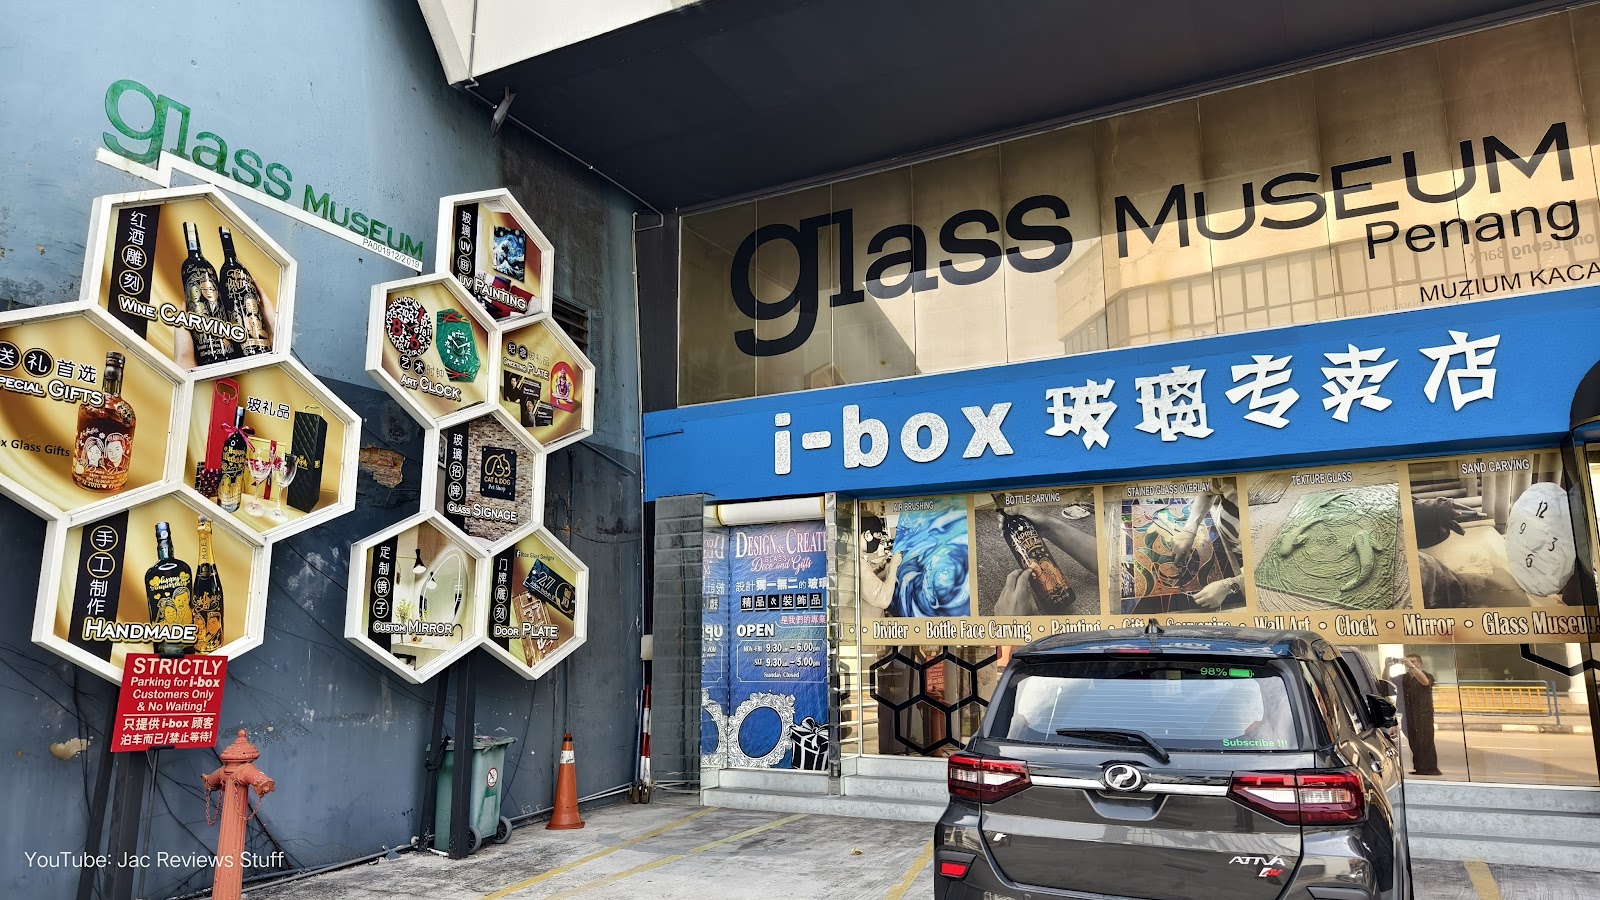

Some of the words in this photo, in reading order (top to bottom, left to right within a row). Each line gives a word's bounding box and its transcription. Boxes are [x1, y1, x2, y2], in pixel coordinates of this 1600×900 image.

[102, 79, 292, 202] glass
[303, 184, 424, 261] MUSEUM
[1365, 199, 1580, 260] Penang
[730, 194, 1073, 357] glass
[1114, 121, 1574, 258] MUSEUM
[362, 238, 420, 268] PA001912/2019
[1420, 273, 1521, 303] MUZIUM
[1530, 261, 1600, 287] KACA
[459, 276, 472, 287] UV
[475, 278, 526, 308] PAINTING
[119, 295, 156, 317] WINE
[160, 304, 245, 340] CARVING
[528, 363, 550, 379] PLATE
[0, 377, 44, 394] PECIAL
[49, 380, 104, 405] GIFTS
[401, 375, 418, 388] ART
[420, 376, 461, 399] CLOCK
[247, 397, 290, 420] 玻礼品
[774, 402, 1014, 475] i-box
[1045, 329, 1501, 450] 玻璃专卖店
[11, 440, 41, 453] Glass
[44, 445, 70, 457] Gifts
[1461, 461, 1487, 474] SAND
[1489, 458, 1530, 473] CARVING
[499, 477, 511, 485] DOG
[1291, 473, 1326, 486] TEXTURE
[1327, 471, 1353, 483] GLASS
[1127, 485, 1154, 497] STAINED
[1156, 484, 1178, 495] GLASS
[1180, 482, 1211, 493] OVERLAY
[893, 502, 903, 512] AIR
[904, 501, 934, 511] BRUSHING
[1005, 495, 1030, 505] BOTTLE
[1031, 492, 1060, 503] CARVING
[448, 502, 470, 515] GLASS
[473, 504, 517, 521] SIGNAGE
[1535, 501, 1548, 519] 12
[1518, 522, 1527, 534] 9
[736, 531, 777, 558] DESIGN
[1547, 537, 1558, 551] 3
[86, 531, 113, 616] 手工制作
[85, 619, 198, 641] HANDMADE
[373, 621, 406, 633] CUSTOM
[408, 620, 453, 634] MIRROR
[495, 625, 519, 636] DOOR
[522, 622, 558, 637] PLATE
[736, 623, 775, 637] OPEN
[872, 621, 909, 640] Divider
[925, 620, 957, 639] Bottle
[959, 620, 986, 639] Face
[988, 619, 1032, 642] Carving
[1254, 616, 1285, 630] Wall
[1288, 615, 1310, 631] Art
[1334, 614, 1379, 636] Clock
[1402, 613, 1455, 636] Mirror
[1482, 612, 1529, 635] Glass
[133, 657, 223, 676] STRICTLY
[1200, 667, 1228, 677] 98%
[131, 676, 171, 689] Parking
[173, 677, 188, 687] for
[189, 675, 221, 688] i-box
[133, 689, 189, 699] Customers
[192, 689, 214, 701] Only
[137, 702, 145, 711] &
[148, 702, 163, 711] No
[165, 700, 207, 713] Waiting!
[122, 717, 160, 731] 只提供
[162, 718, 189, 728] i-box
[1222, 738, 1275, 747] Subscribe
